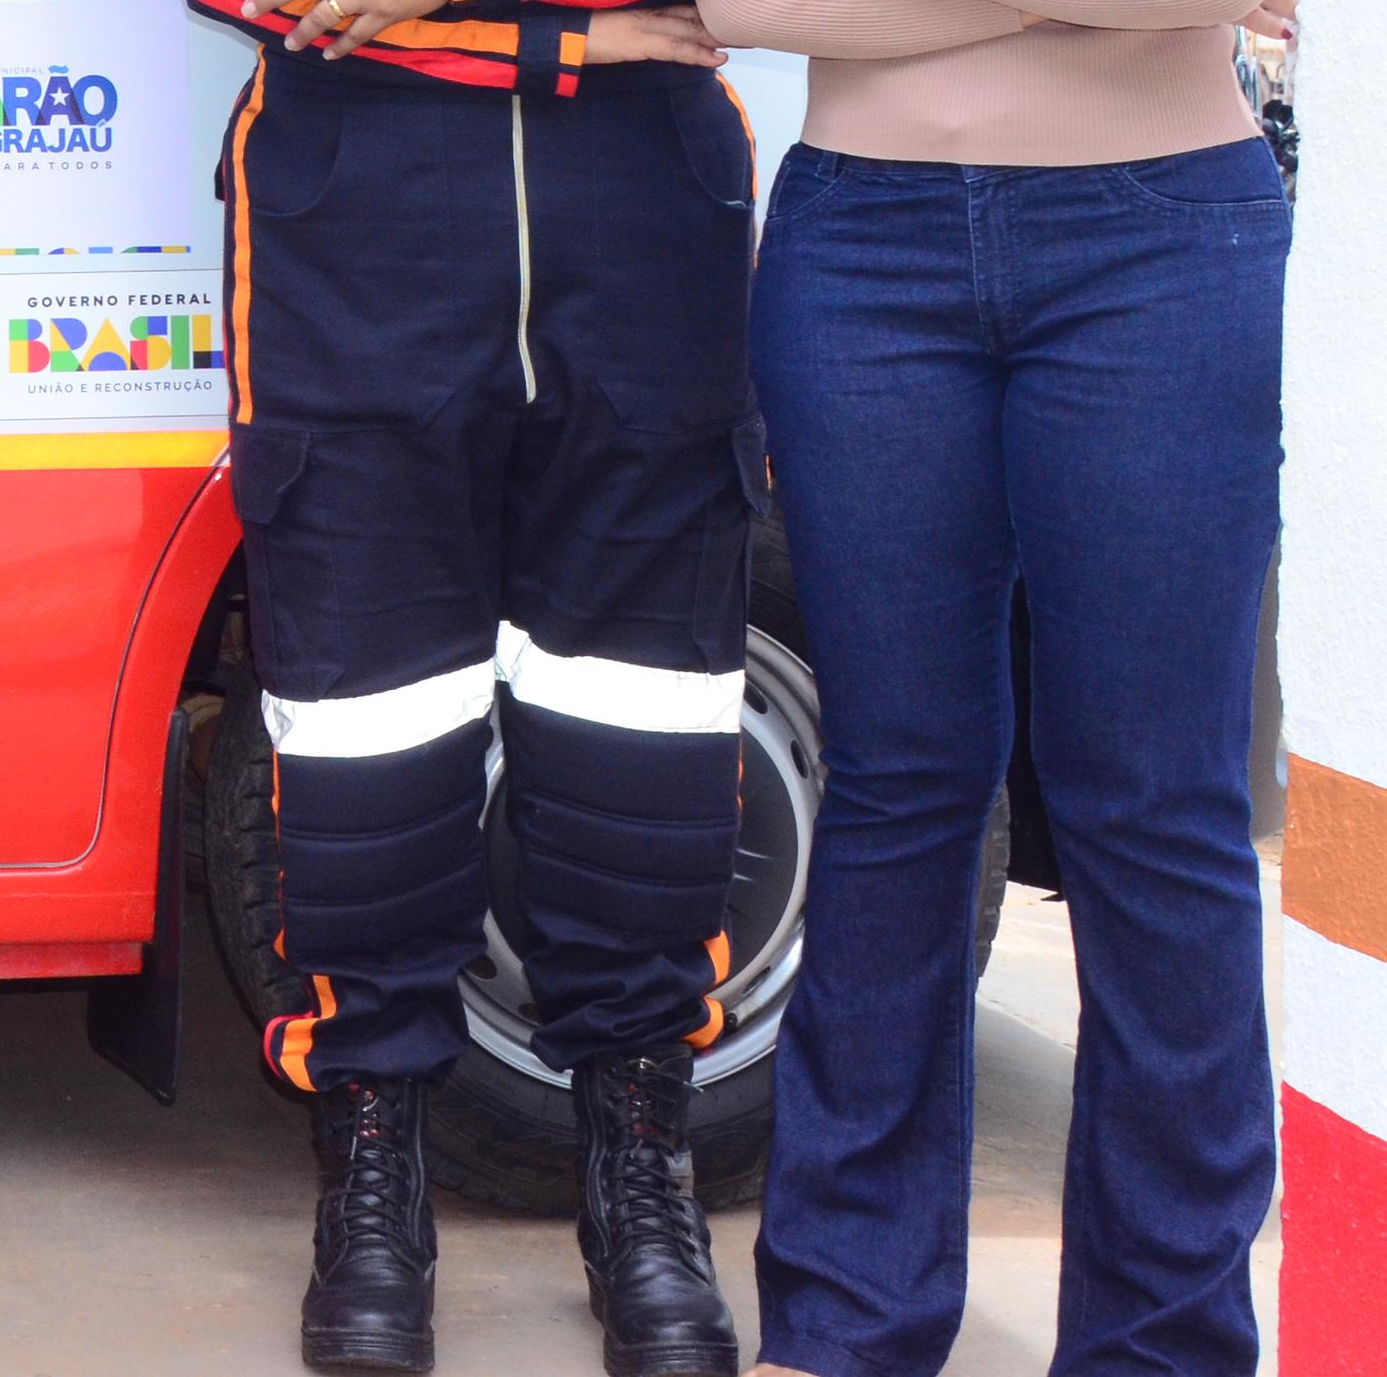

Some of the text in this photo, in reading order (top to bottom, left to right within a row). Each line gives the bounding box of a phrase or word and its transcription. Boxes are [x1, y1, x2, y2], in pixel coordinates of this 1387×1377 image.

[49, 160, 113, 171] TODOS
[27, 292, 212, 309] GOVERNO FEDERAL
[9, 313, 224, 374] BRASIL
[27, 378, 214, 395] UNIÃO E RECONSTRUÇÃO
